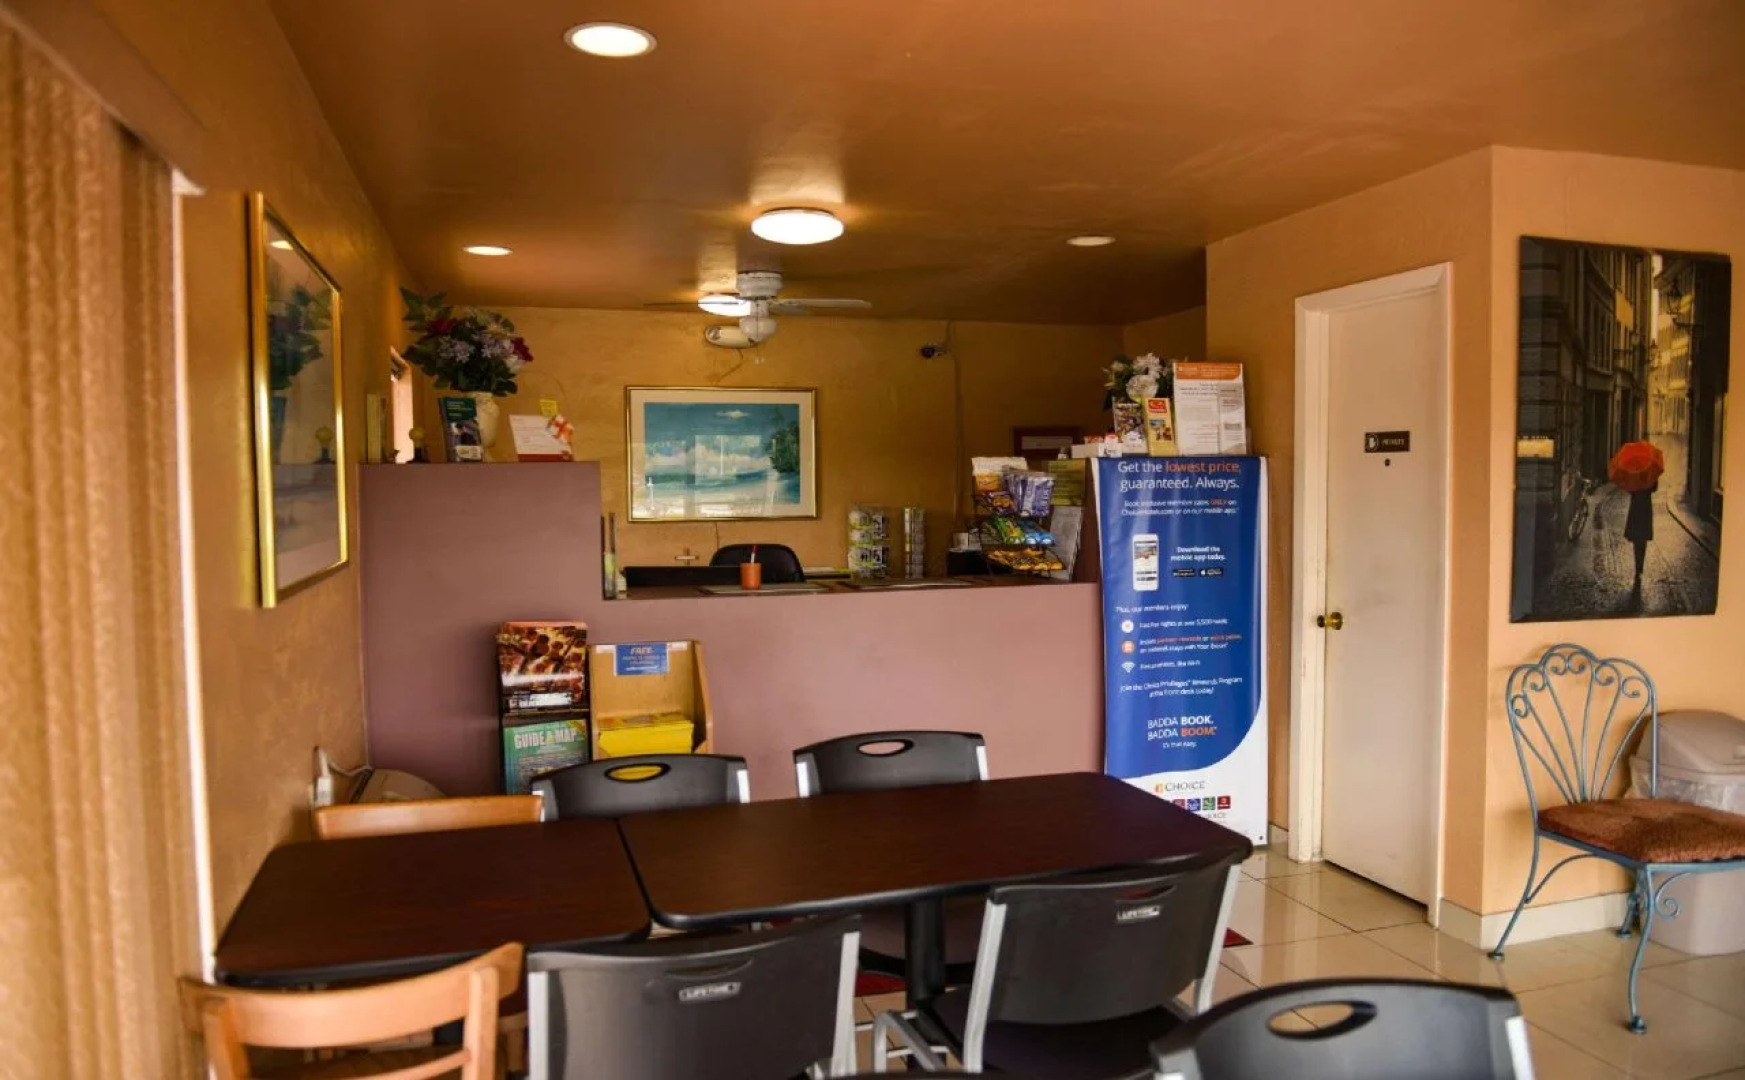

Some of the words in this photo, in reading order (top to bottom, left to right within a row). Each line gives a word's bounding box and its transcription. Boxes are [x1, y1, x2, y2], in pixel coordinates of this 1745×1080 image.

[1118, 461, 1140, 473] Get
[1142, 461, 1163, 473] the
[1165, 461, 1205, 473] lowest
[1120, 477, 1193, 492] guaranteed.
[1195, 476, 1240, 492] Always.
[1147, 717, 1179, 729] BADDA
[1181, 715, 1214, 725] BOOK.
[514, 731, 545, 750] GUIDE
[1147, 728, 1179, 741] BADDA
[1165, 780, 1206, 792] CHOICE
